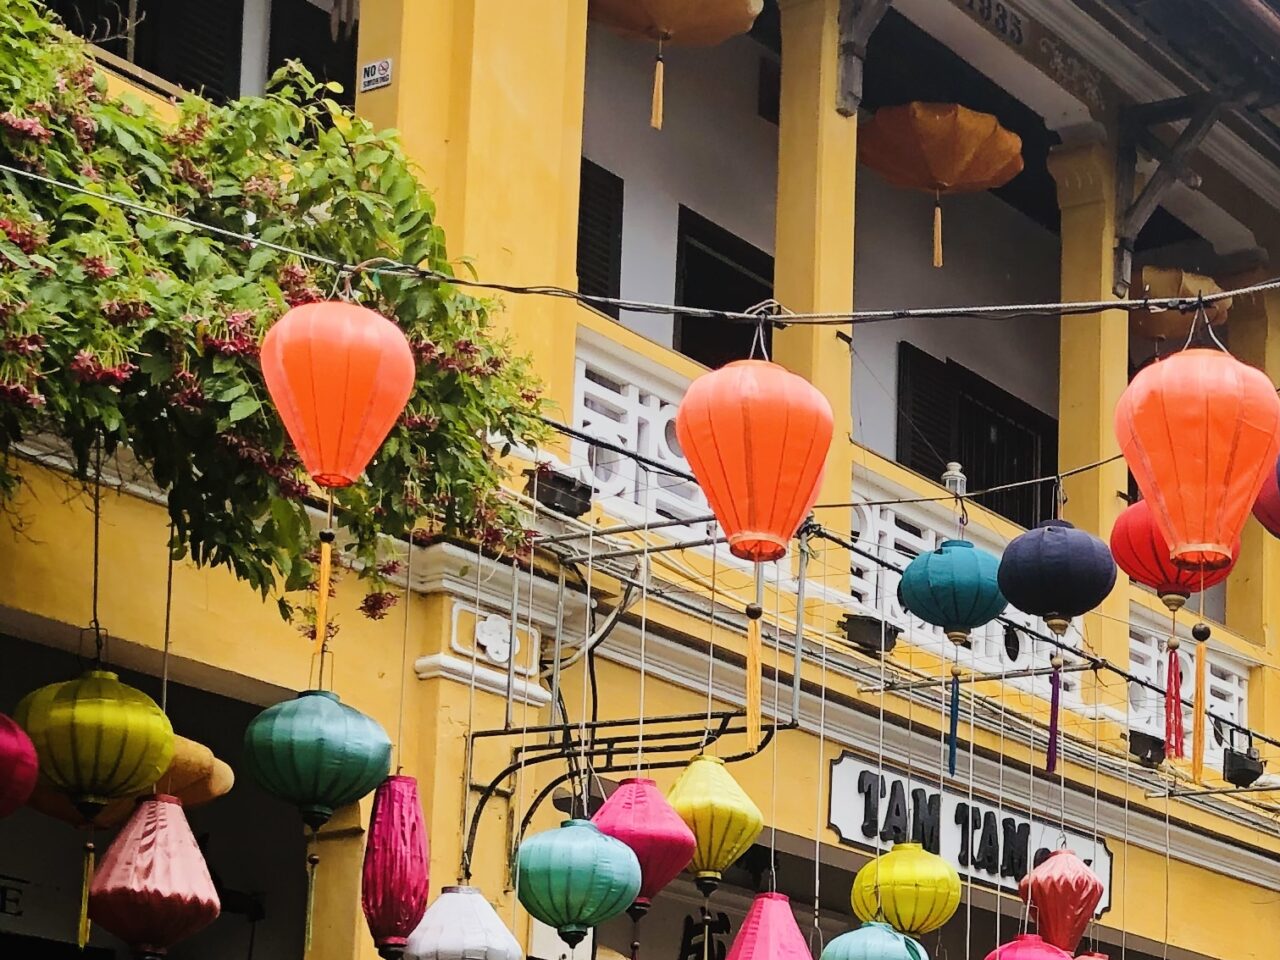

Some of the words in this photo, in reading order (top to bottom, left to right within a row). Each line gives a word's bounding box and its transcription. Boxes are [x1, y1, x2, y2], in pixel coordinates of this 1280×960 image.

[363, 65, 377, 79] NO
[858, 769, 941, 855] TAM
[954, 802, 1031, 883] TAM
